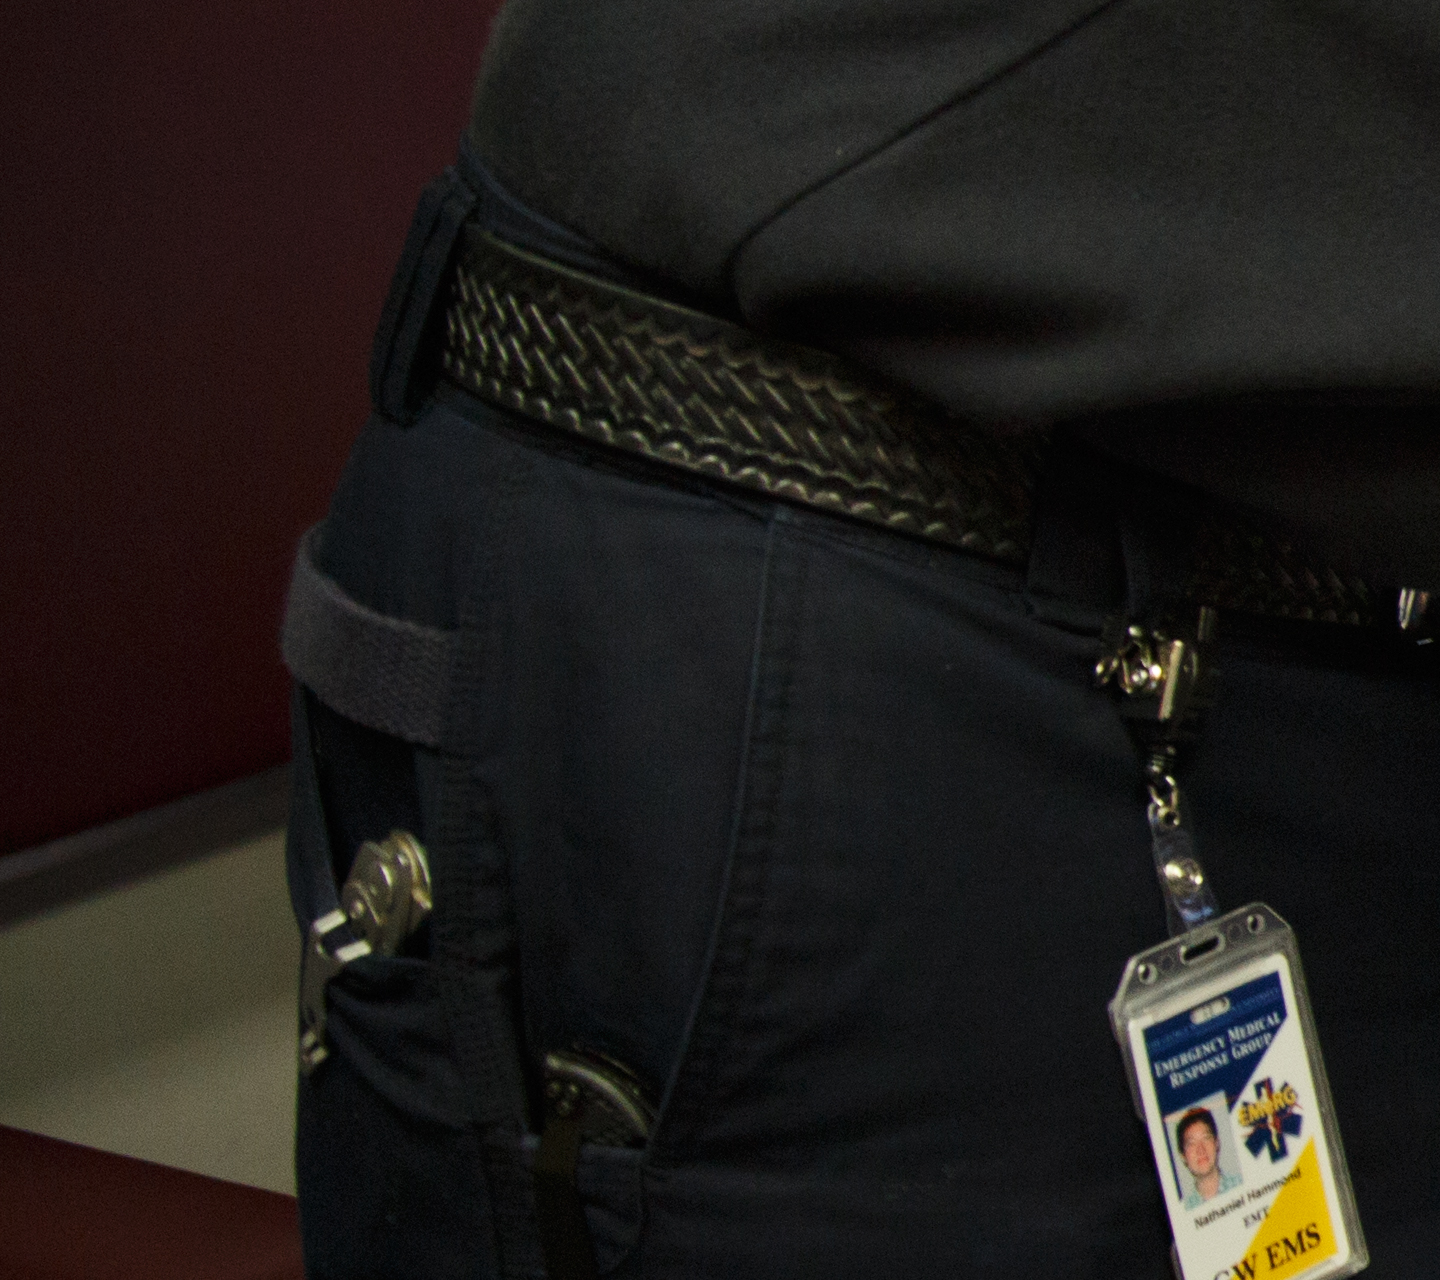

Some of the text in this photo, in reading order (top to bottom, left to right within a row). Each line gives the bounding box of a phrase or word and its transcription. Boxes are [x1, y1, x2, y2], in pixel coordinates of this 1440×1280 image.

[1154, 1035, 1227, 1078] EMERGENCY
[1169, 1051, 1231, 1089] RESPONSE
[1194, 1167, 1302, 1229] Nathaniel Hammond
[1242, 1206, 1270, 1228] EMT
[1266, 1222, 1321, 1271] EMS
